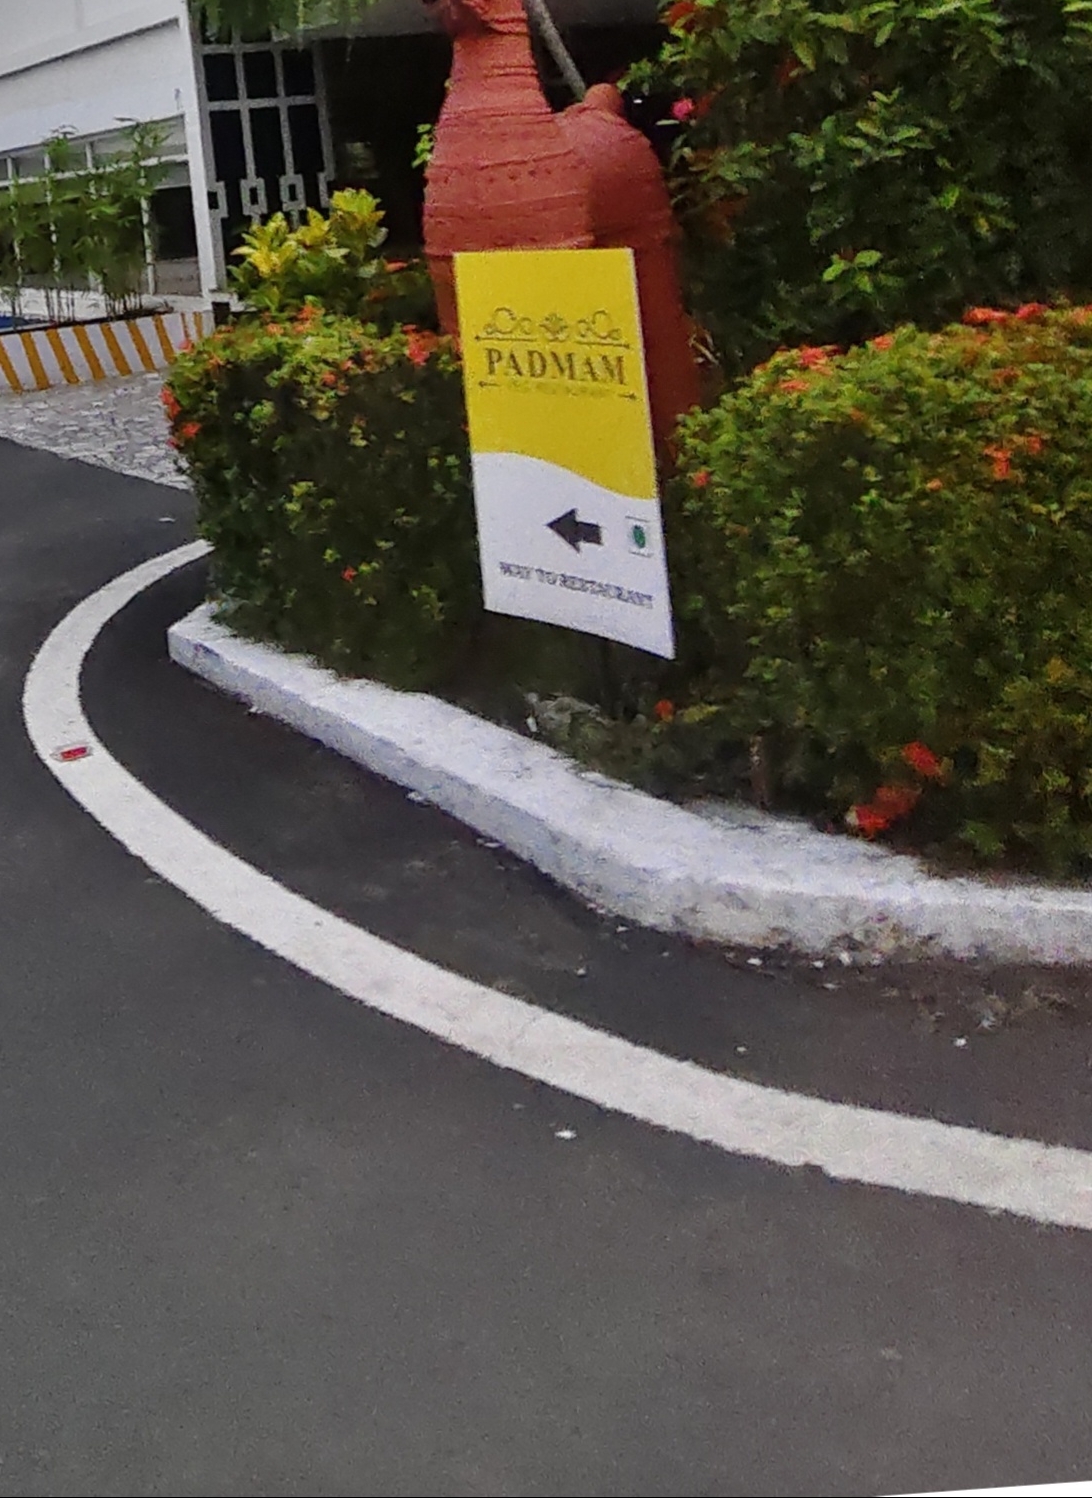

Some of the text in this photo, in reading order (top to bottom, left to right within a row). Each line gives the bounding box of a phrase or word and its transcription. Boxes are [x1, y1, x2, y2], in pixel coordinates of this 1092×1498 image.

[484, 347, 627, 386] PADMAM
[534, 567, 557, 586] TO
[558, 572, 654, 610] RESTAURANT
